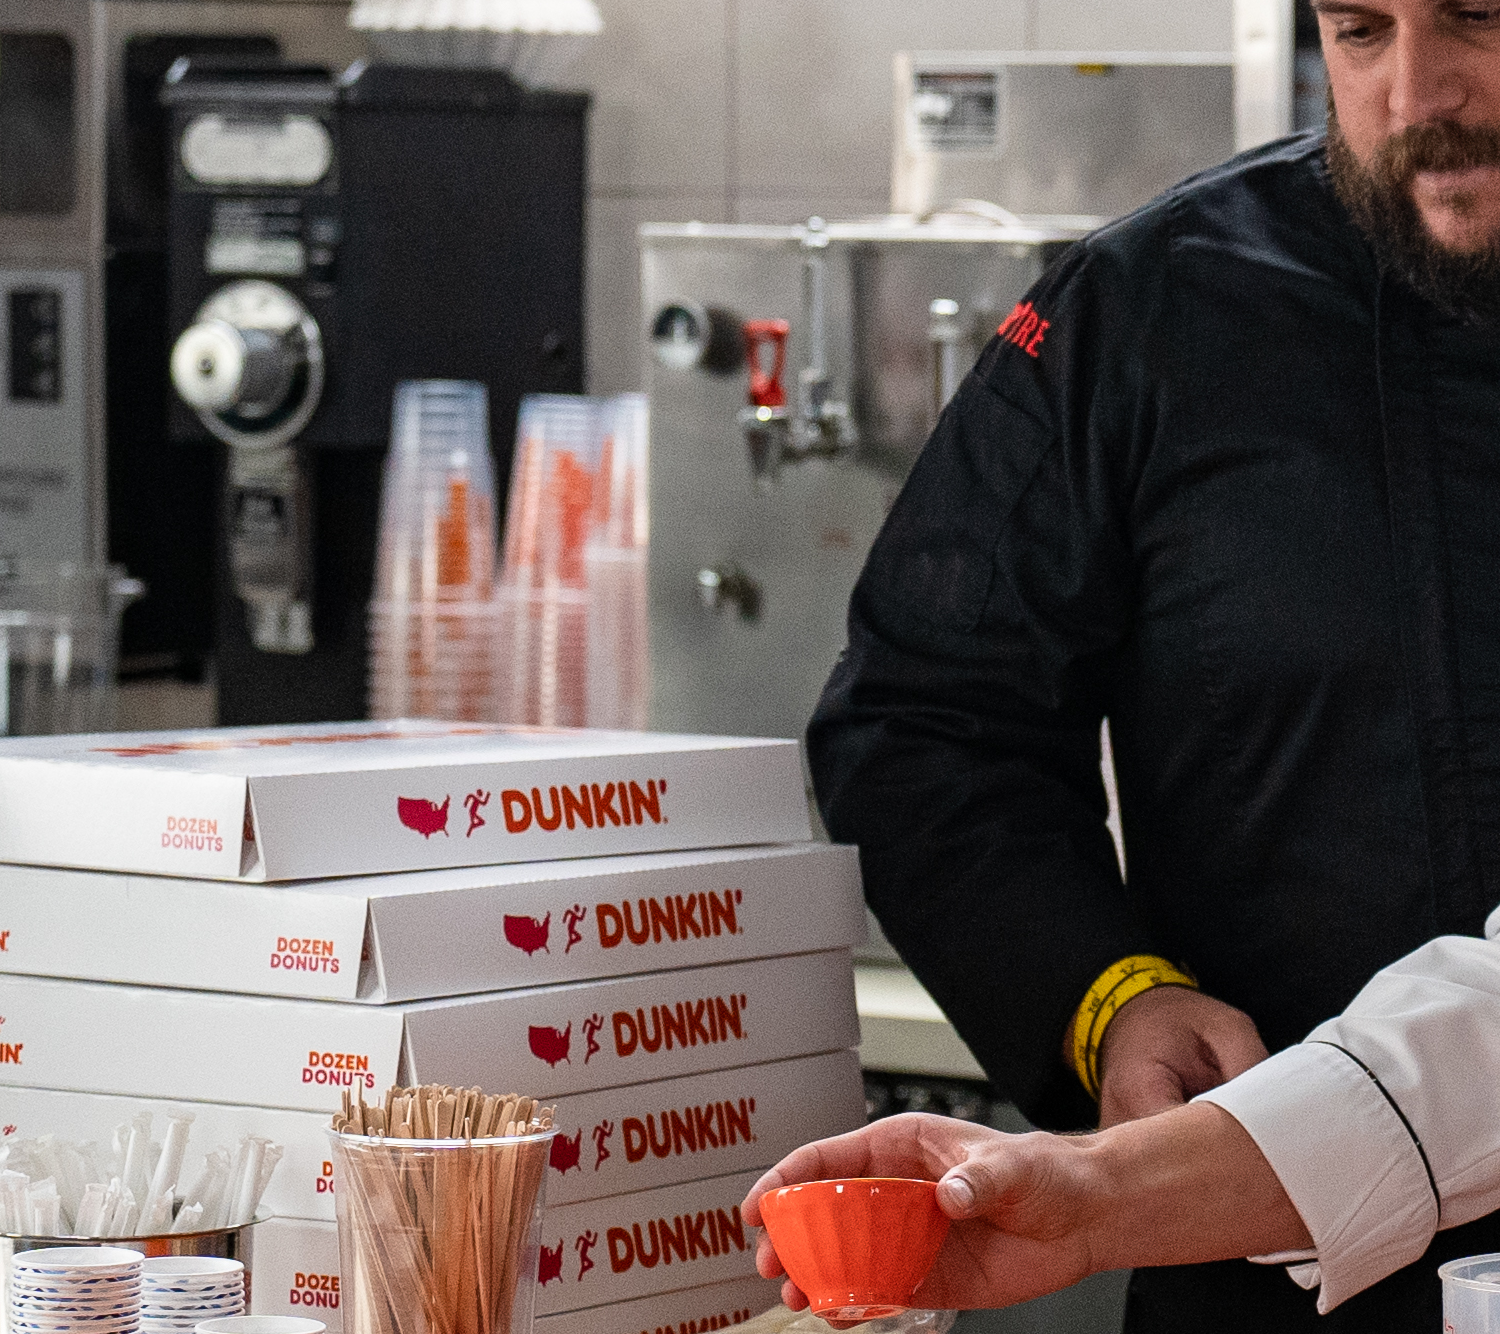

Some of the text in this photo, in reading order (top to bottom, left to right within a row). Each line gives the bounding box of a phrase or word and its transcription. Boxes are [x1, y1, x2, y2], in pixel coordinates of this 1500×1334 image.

[501, 778, 668, 834] DUNKIN'
[166, 815, 218, 836] DOZEN
[161, 832, 224, 853] DONUTS
[596, 889, 744, 949] DUNKIN'
[276, 936, 335, 957] DOZEN
[270, 952, 340, 974] DONUTS
[611, 993, 748, 1058] DUNKIN'
[308, 1051, 369, 1072] DOZEN
[621, 1097, 757, 1164] DUNKIN'
[295, 1272, 340, 1292] DOZE
[290, 1289, 340, 1309] DONU
